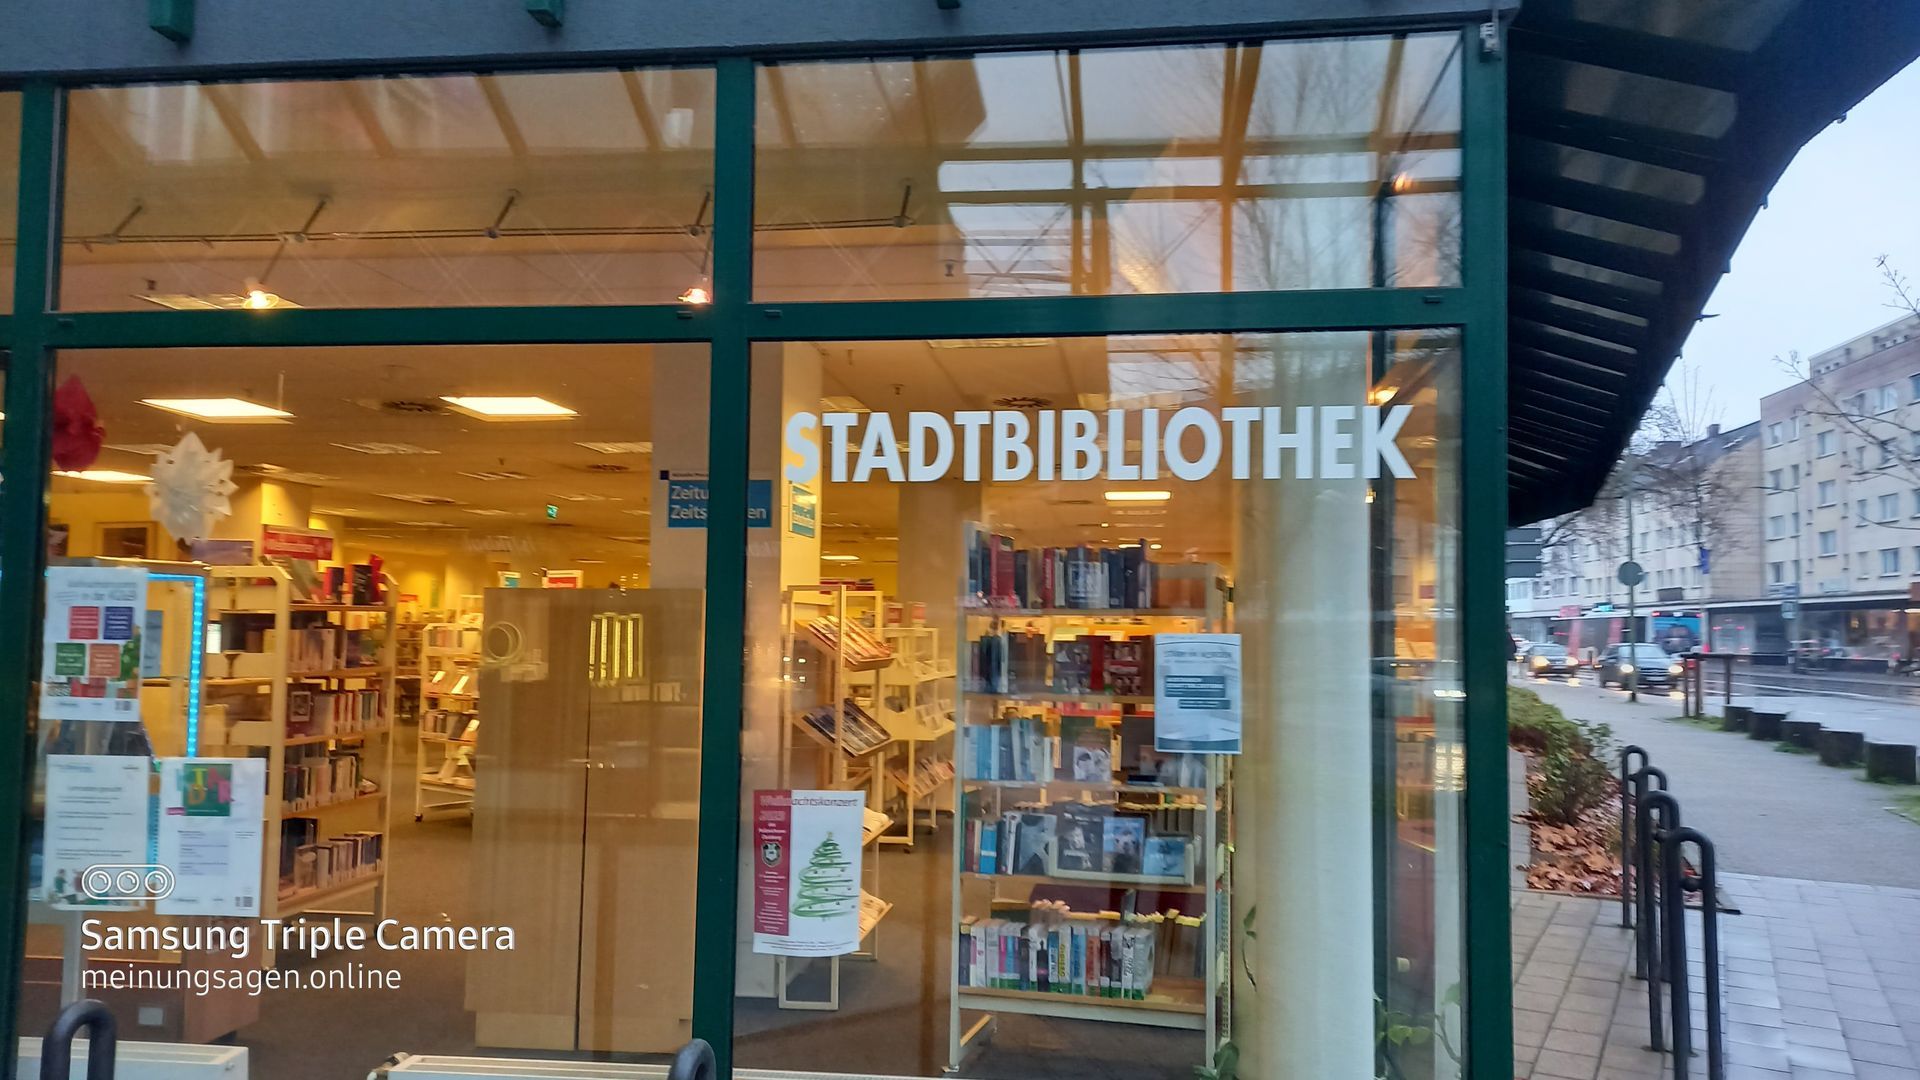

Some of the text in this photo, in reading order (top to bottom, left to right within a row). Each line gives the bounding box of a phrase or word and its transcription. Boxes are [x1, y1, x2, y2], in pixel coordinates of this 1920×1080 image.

[785, 405, 1416, 483] STADTBIBLIOTHEK
[671, 485, 708, 500] Zeitu
[759, 795, 858, 807] Wachtskonzert
